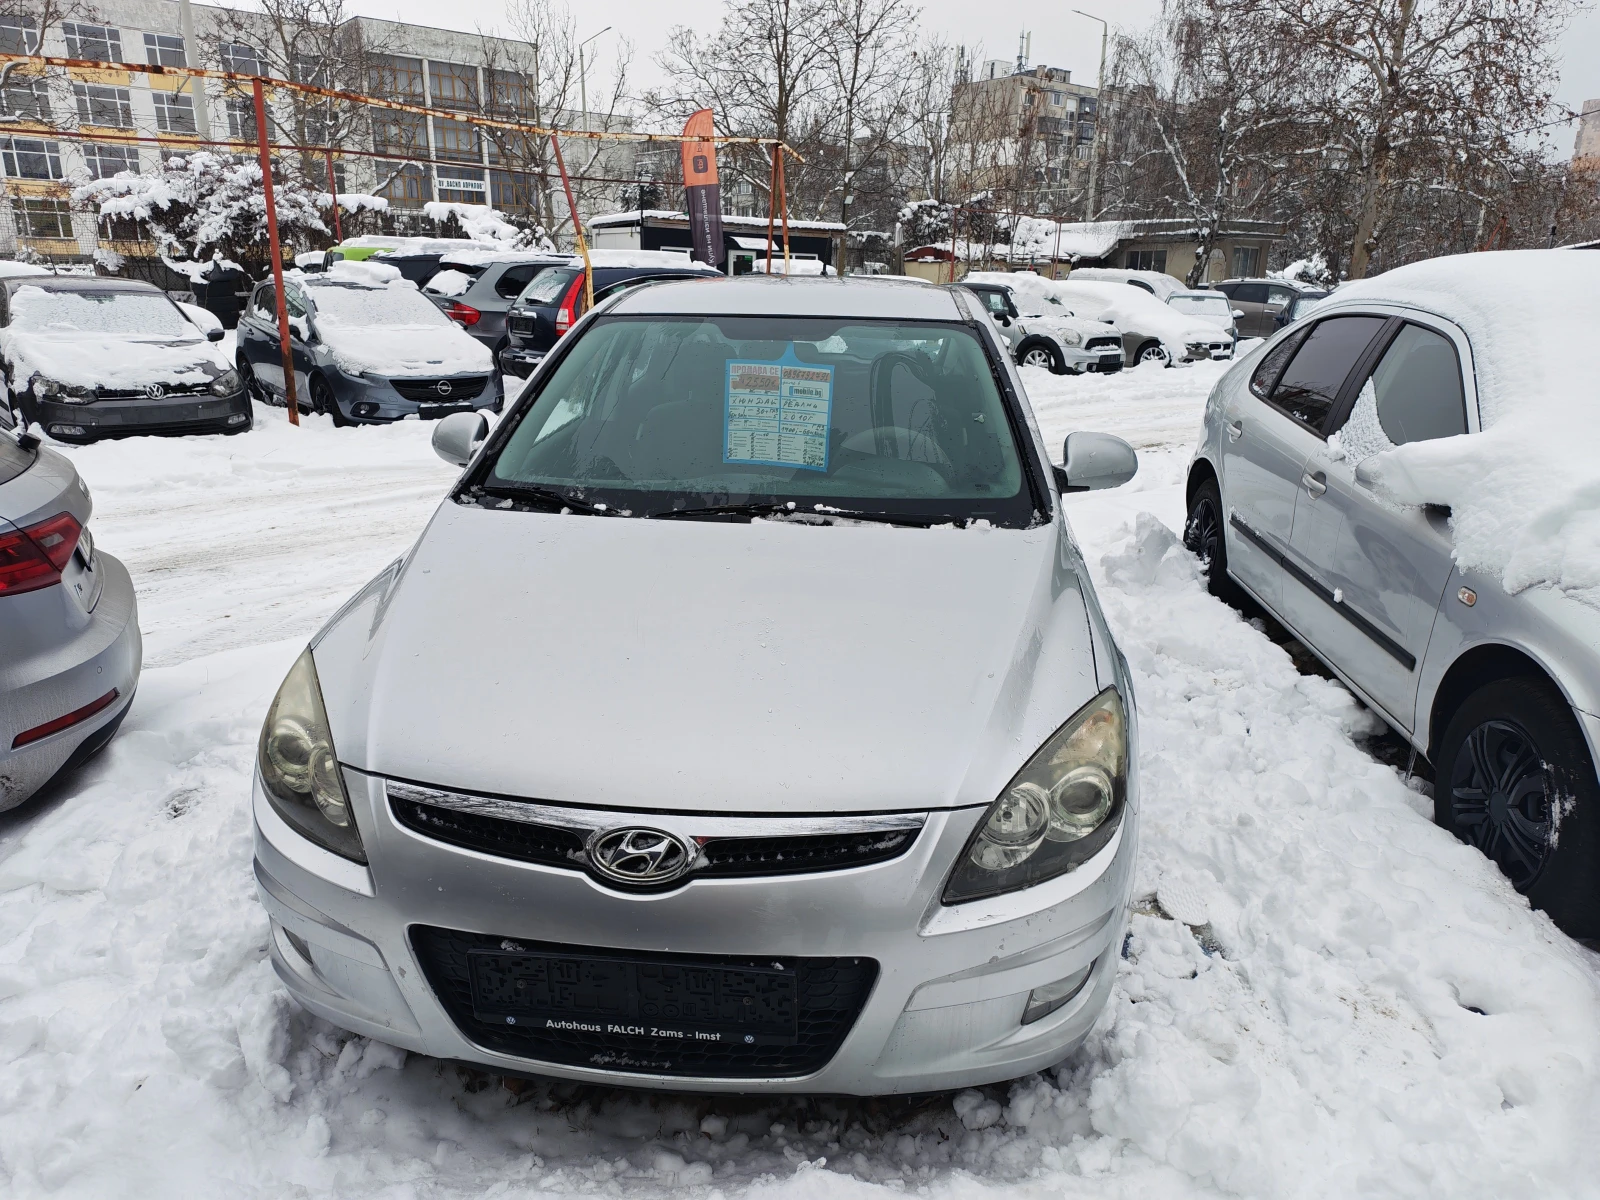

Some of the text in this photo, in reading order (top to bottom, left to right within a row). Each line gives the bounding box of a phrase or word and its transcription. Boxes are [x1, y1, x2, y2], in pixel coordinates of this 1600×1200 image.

[701, 189, 709, 233] изплащане
[706, 234, 711, 244] на
[731, 365, 780, 375] ПРОДАВА СЕ
[793, 388, 822, 397] mobile.bg
[546, 1019, 601, 1032] Autohaus
[607, 1024, 645, 1035] FALCH
[650, 1028, 684, 1038] Zams
[695, 1031, 721, 1041] Imst
